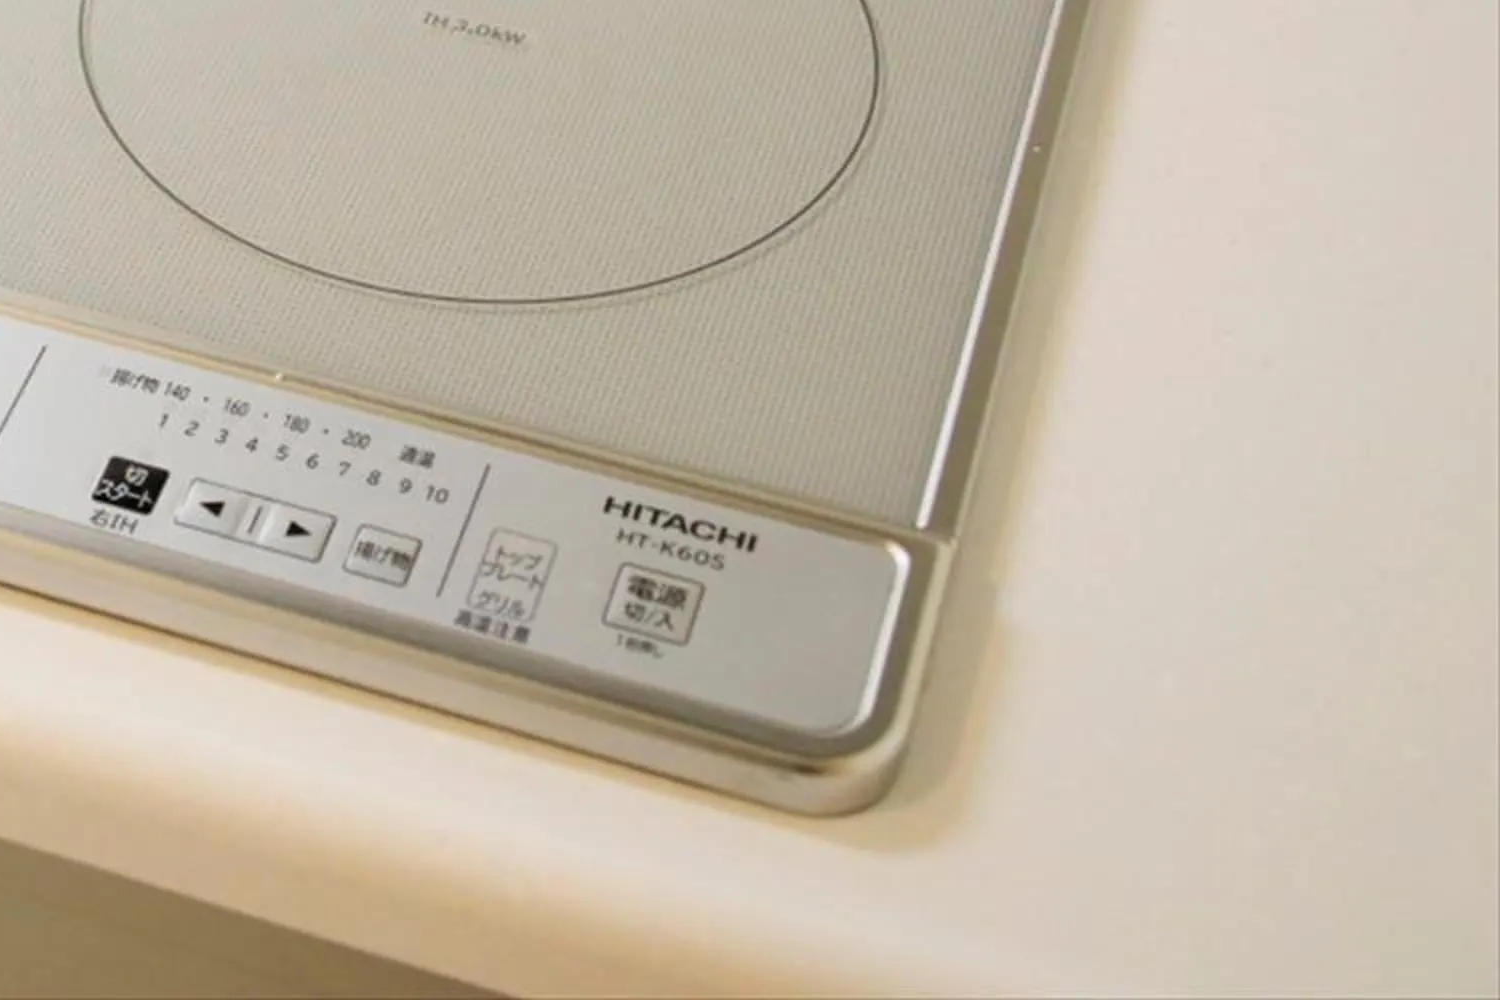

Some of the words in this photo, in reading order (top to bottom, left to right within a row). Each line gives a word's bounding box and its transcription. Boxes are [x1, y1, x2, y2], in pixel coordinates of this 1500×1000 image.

[159, 412, 171, 429] 1
[183, 420, 200, 437] 2
[213, 428, 230, 446] 3
[245, 436, 260, 453] 4
[274, 443, 290, 462] 5
[305, 452, 321, 470] 6
[338, 460, 352, 477] 7
[365, 469, 382, 487] 8
[398, 477, 413, 495] 9
[425, 484, 450, 505] 10
[89, 507, 140, 535] 右IH
[602, 494, 760, 553] HITACHI
